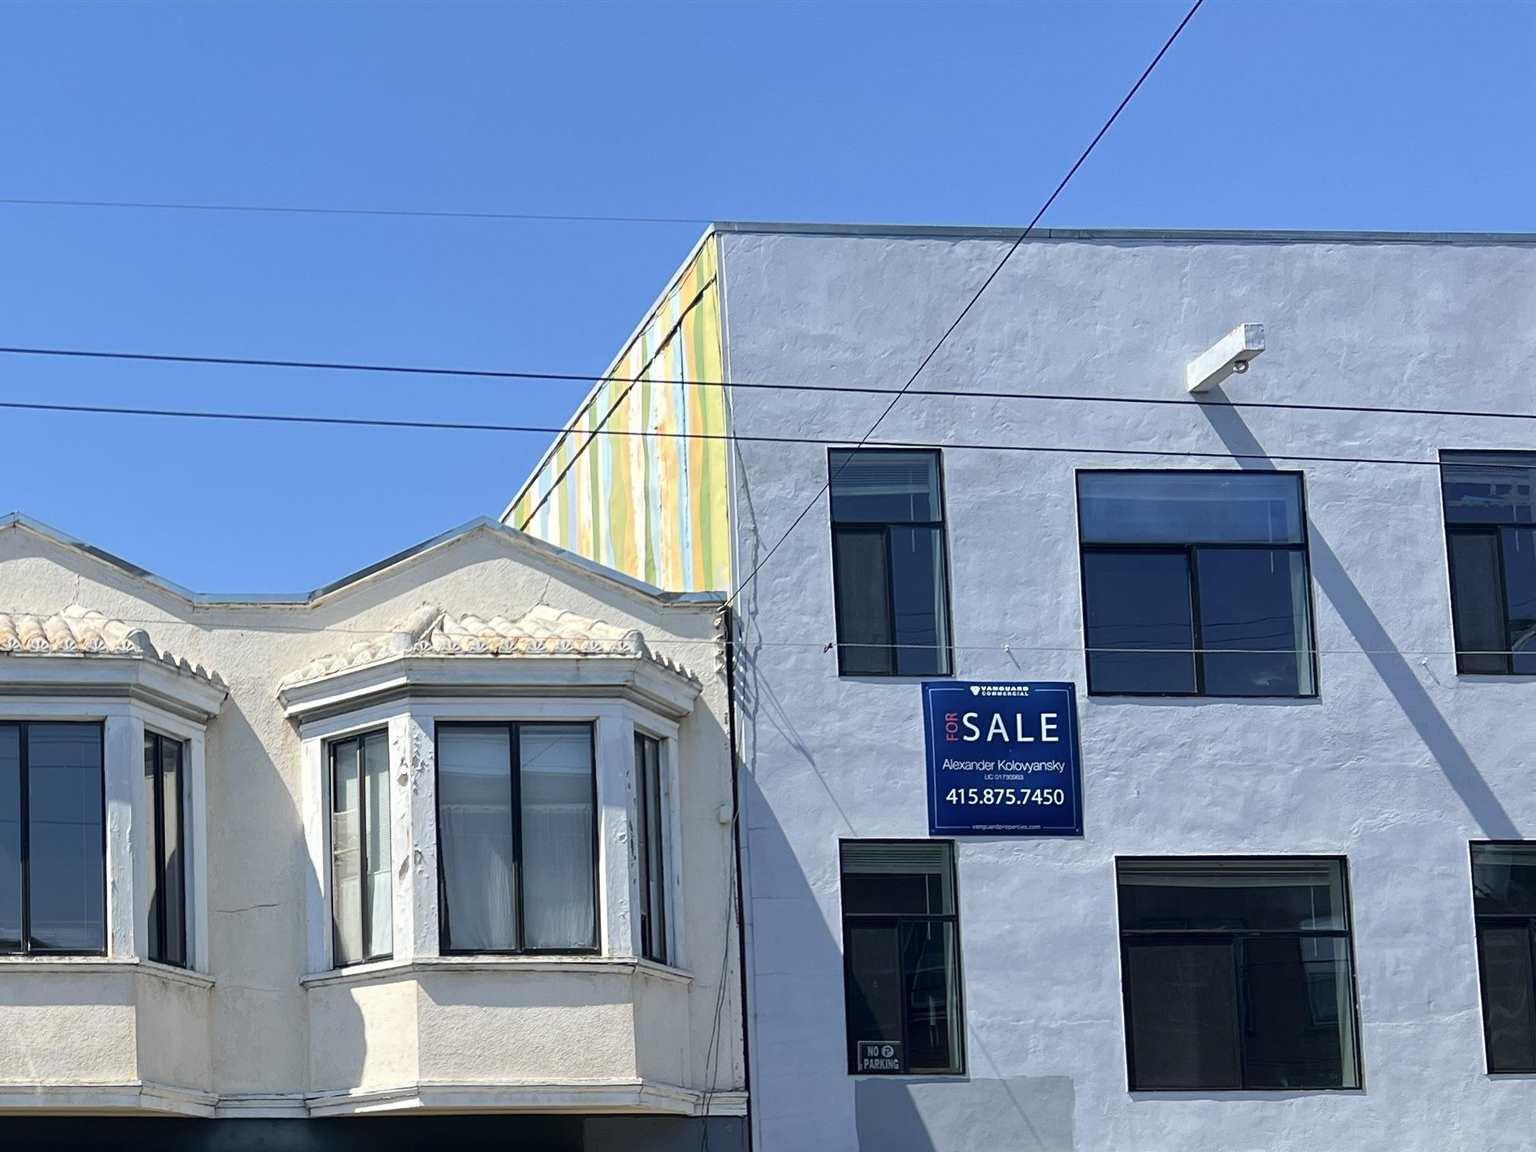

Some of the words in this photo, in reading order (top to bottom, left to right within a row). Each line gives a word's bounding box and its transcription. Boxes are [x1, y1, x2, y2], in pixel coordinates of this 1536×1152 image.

[945, 712, 958, 741] FOR
[962, 712, 1059, 742] SALE
[942, 759, 995, 771] Alexander
[998, 760, 1065, 774] Kolovyansky
[946, 788, 1064, 805] 415.875.7450
[867, 1045, 879, 1057] NO
